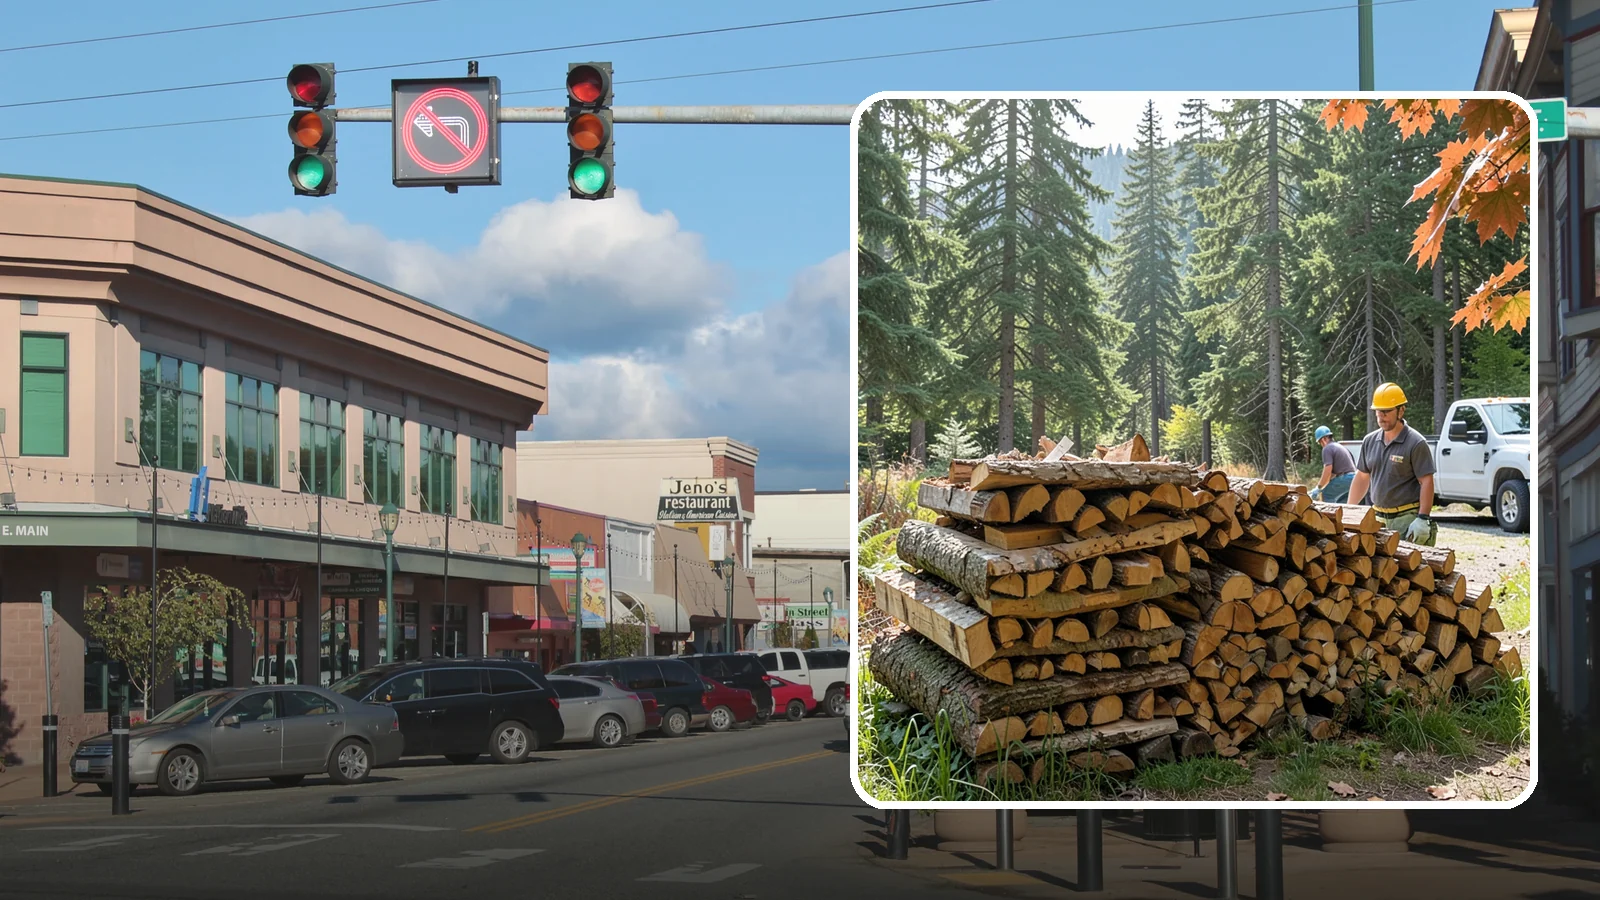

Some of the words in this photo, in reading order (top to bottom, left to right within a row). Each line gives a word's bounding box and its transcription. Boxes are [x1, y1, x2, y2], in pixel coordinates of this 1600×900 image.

[670, 480, 727, 494] Jeno's
[665, 496, 730, 509] restaurant
[686, 510, 714, 519] American
[715, 510, 737, 519] Cuisine
[2, 525, 13, 536] E.
[15, 525, 49, 536] MAIN
[797, 608, 828, 617] Street
[790, 619, 823, 627] lass
